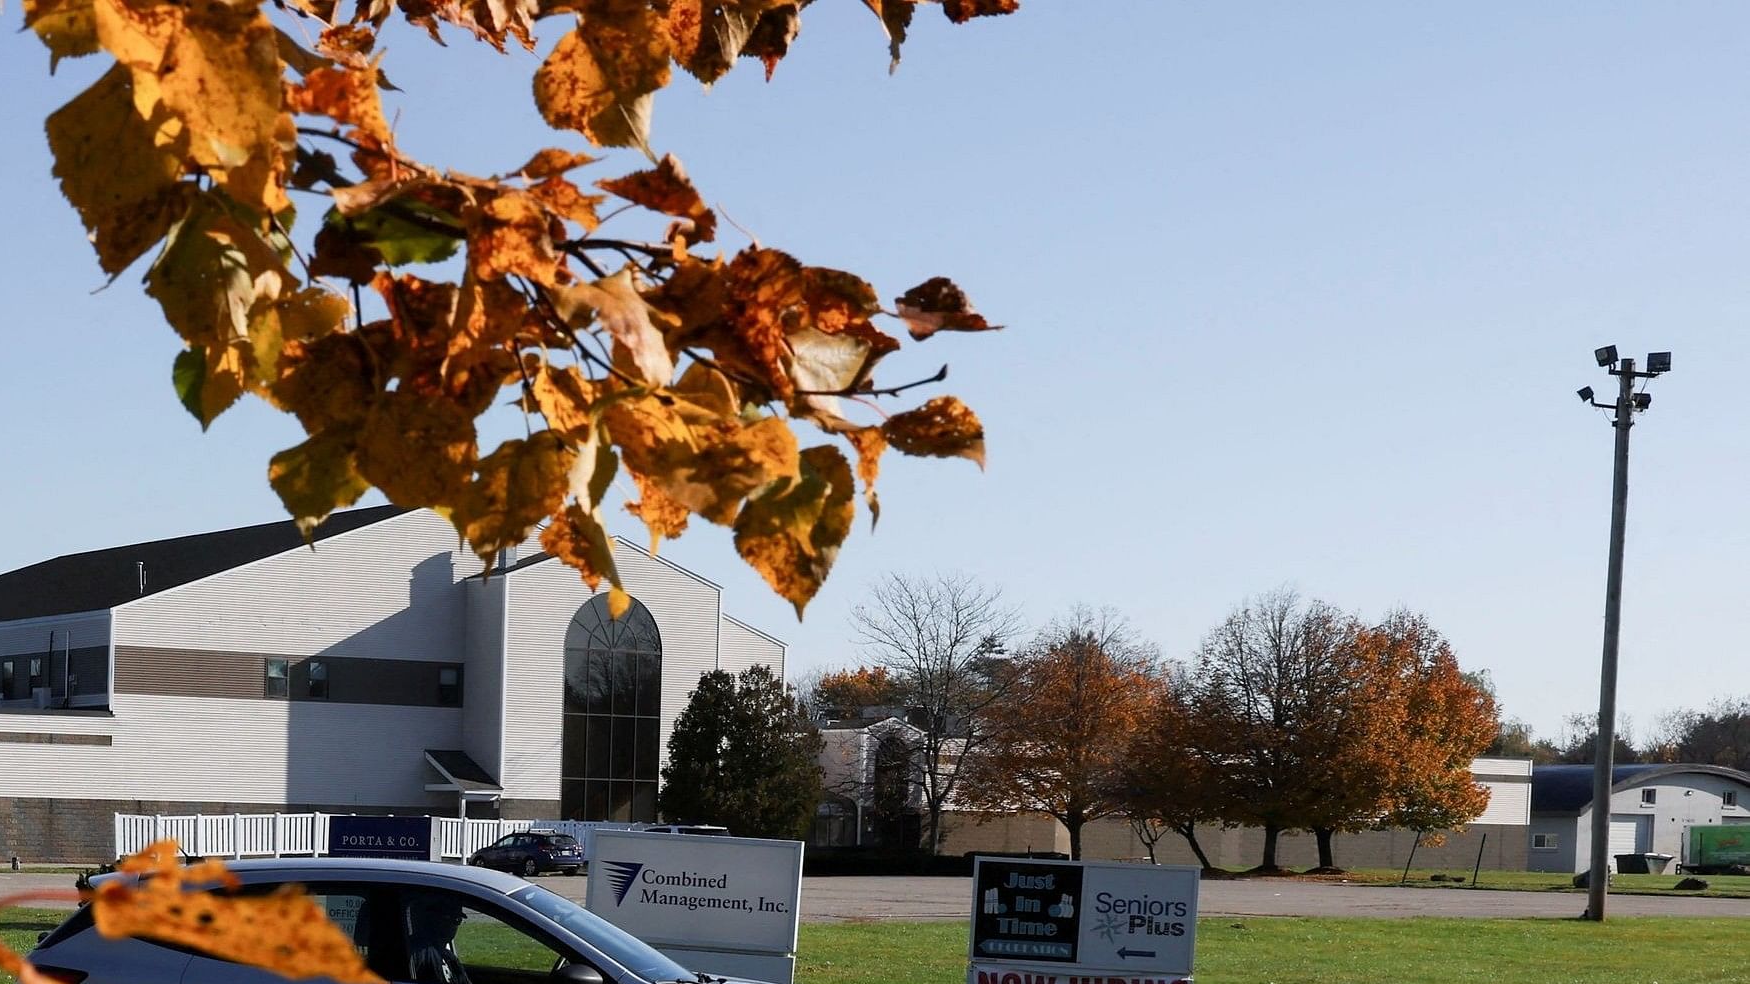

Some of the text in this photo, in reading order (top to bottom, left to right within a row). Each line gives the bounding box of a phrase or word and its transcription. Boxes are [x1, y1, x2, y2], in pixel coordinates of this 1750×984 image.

[342, 835, 419, 847] PORTA & CO.
[641, 869, 727, 889] Combined
[1003, 872, 1056, 890] Just
[640, 888, 790, 914] Management, Inc.
[1016, 896, 1041, 912] In
[1095, 892, 1187, 917] Seniors
[996, 917, 1058, 937] Time
[1129, 914, 1185, 937] Plus
